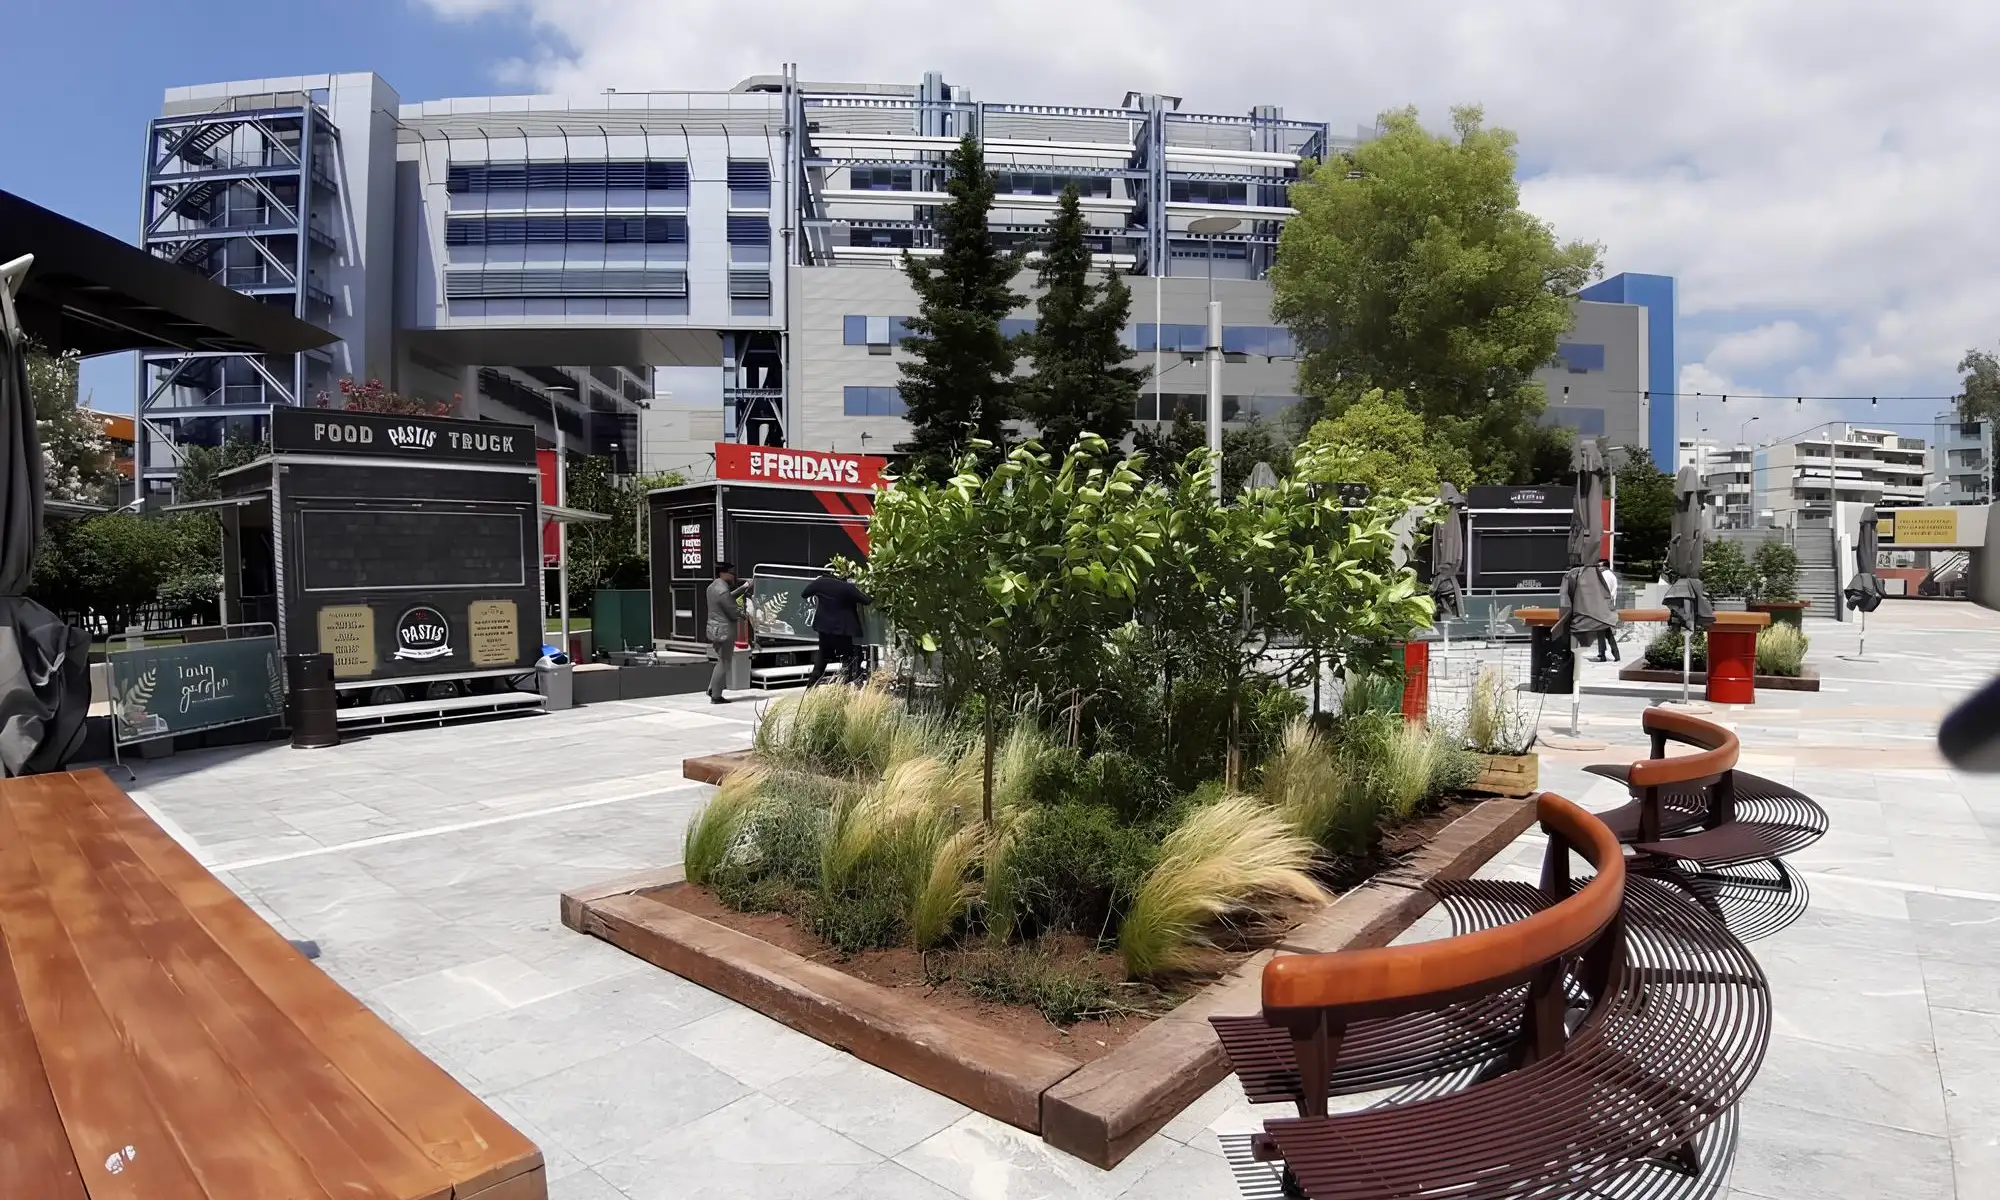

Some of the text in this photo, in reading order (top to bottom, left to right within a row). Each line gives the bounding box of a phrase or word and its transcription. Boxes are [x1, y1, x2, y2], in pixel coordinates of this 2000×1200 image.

[314, 423, 514, 452] FOOD PASTIS TRUCK
[763, 453, 860, 483] FRIDAYS
[401, 624, 445, 644] PASTIS
